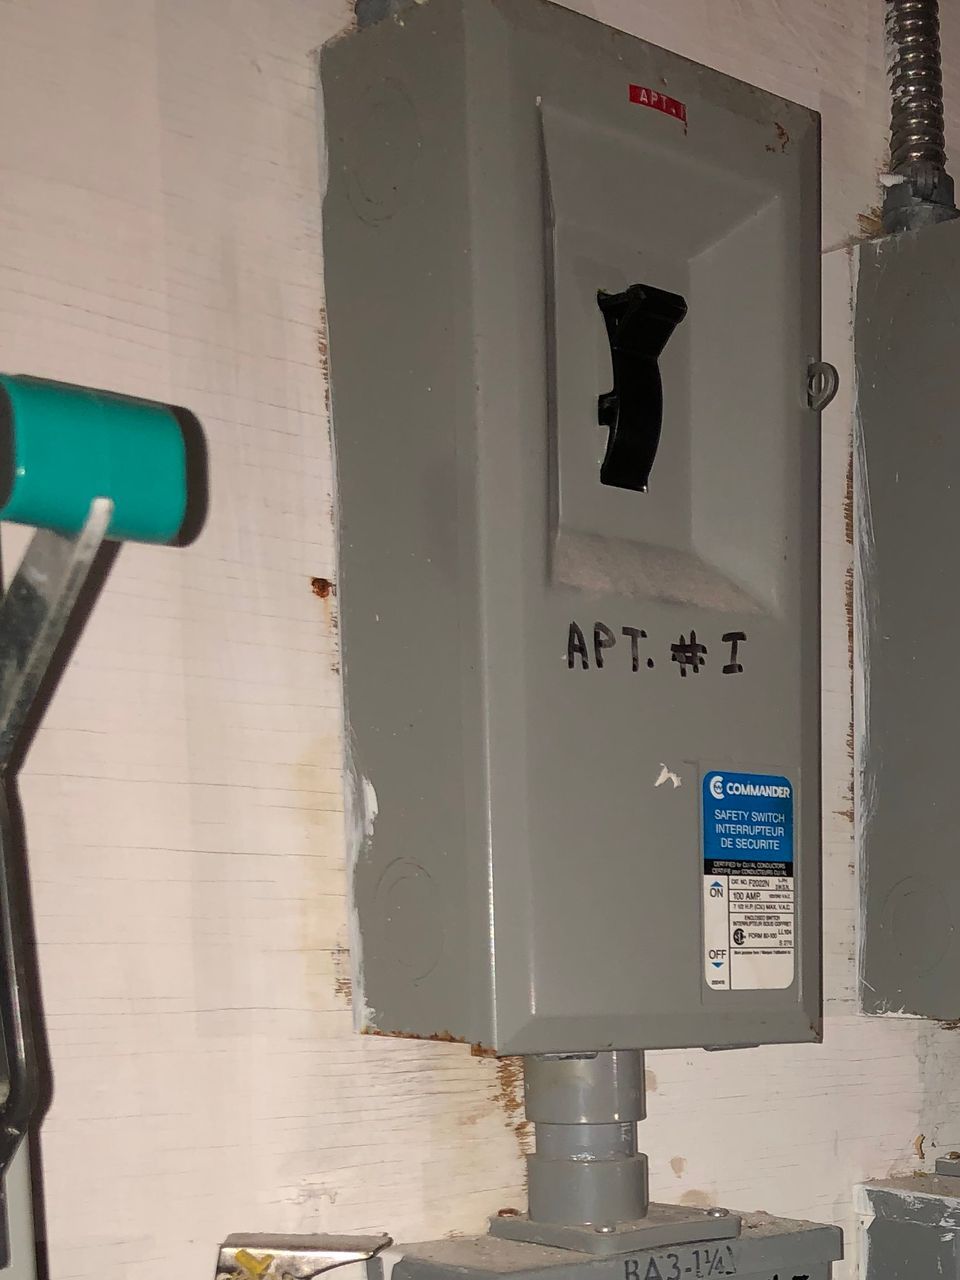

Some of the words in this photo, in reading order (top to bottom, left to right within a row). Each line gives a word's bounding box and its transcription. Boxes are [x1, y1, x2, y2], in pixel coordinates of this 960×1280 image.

[567, 621, 654, 672] APT.
[726, 782, 790, 798] COMMANDER
[714, 809, 749, 821] SAFETY
[751, 811, 785, 823] SWITCH
[715, 824, 785, 837] INTERRUPTEUR
[720, 837, 734, 848] DE
[735, 838, 780, 850] SECURITE
[709, 887, 724, 898] ON
[733, 892, 744, 900] 100
[708, 949, 727, 959] OFF
